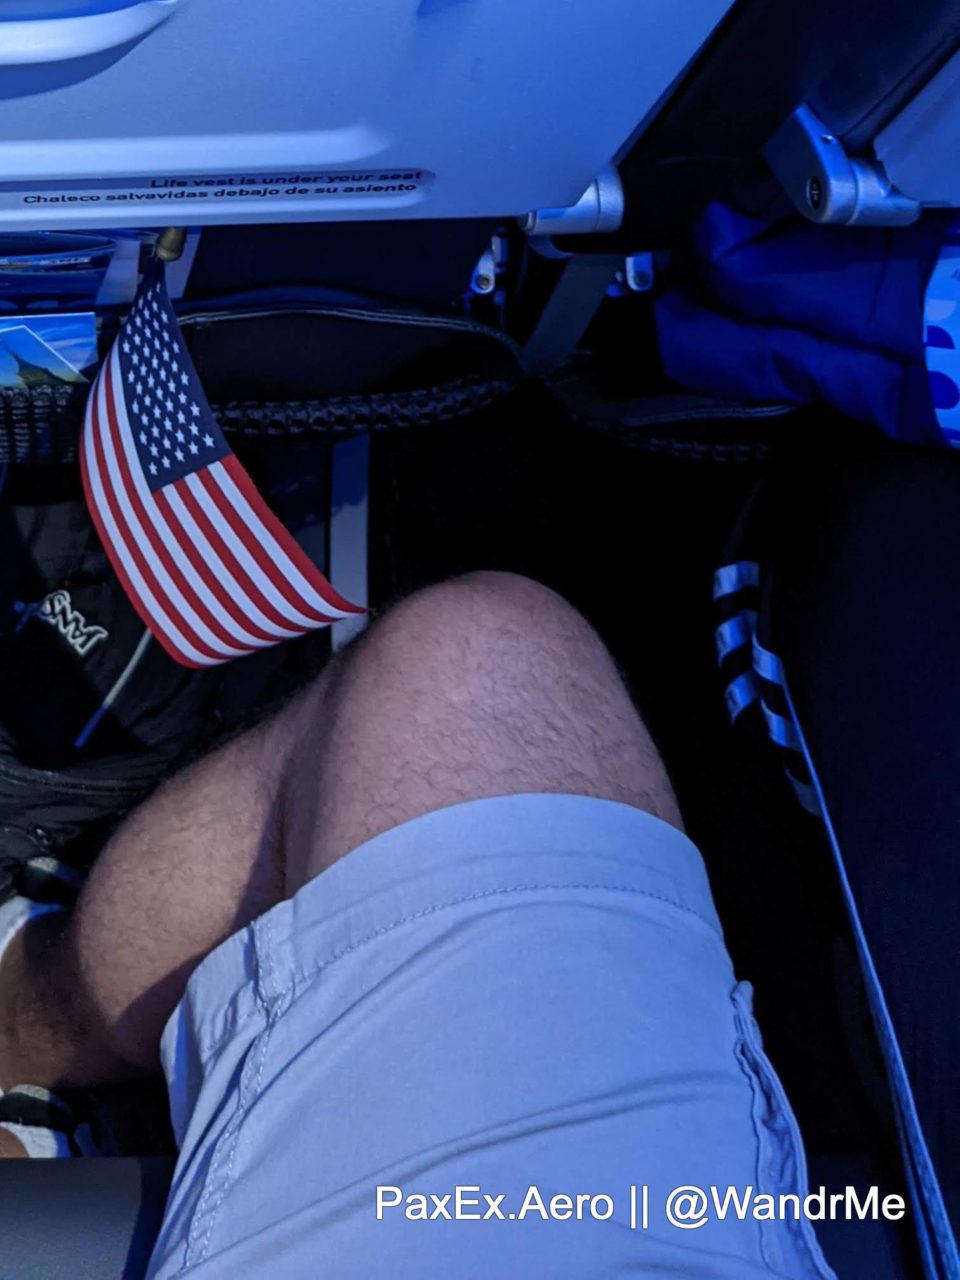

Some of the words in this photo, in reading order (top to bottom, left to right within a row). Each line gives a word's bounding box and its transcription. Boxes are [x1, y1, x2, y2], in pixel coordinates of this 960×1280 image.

[150, 178, 189, 189] Life
[192, 176, 235, 187] vest
[239, 176, 257, 186] is
[261, 174, 324, 185] under
[326, 172, 374, 185] your
[377, 170, 424, 181] seat
[23, 192, 102, 205] Chaleco
[105, 189, 209, 201] salvavidas
[212, 187, 281, 198] debajo
[283, 185, 310, 196] de
[313, 185, 339, 195] su
[342, 182, 418, 193] asiento
